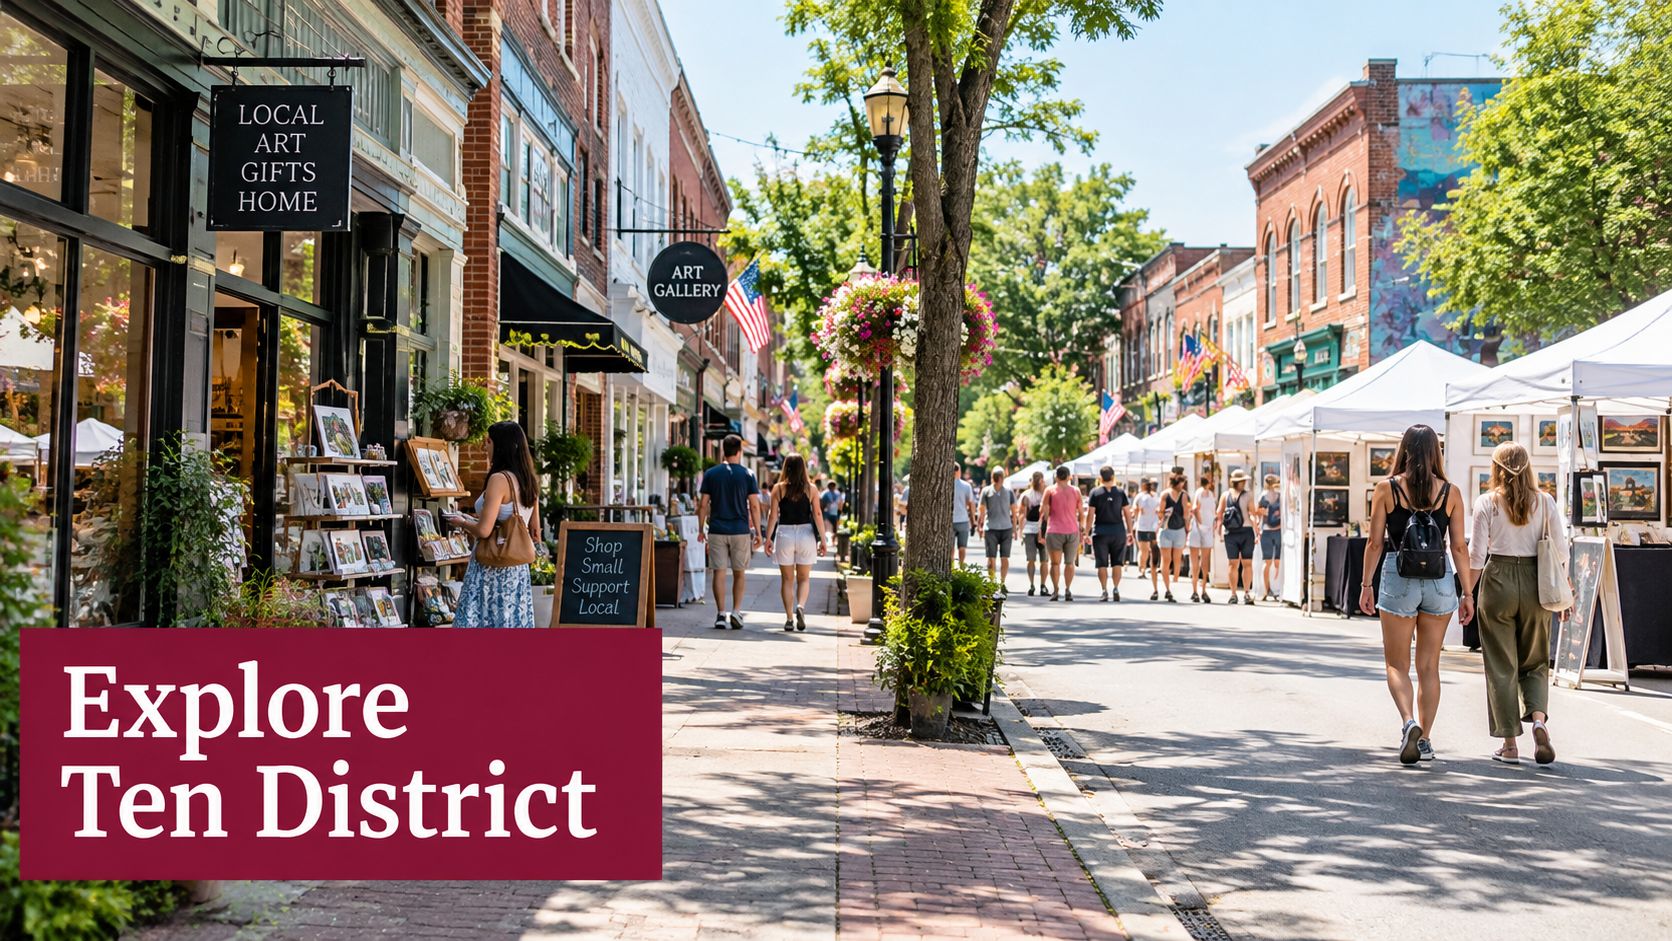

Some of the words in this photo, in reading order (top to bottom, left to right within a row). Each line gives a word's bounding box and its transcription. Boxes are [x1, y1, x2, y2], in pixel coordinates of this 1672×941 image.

[238, 104, 325, 125] LOCAL
[254, 132, 307, 154] ART
[241, 161, 316, 183] GIFTS
[237, 190, 318, 212] HOME
[671, 265, 704, 279] ART
[654, 283, 721, 298] GALLERY
[585, 536, 623, 558] Shop
[581, 557, 624, 575] Small
[571, 577, 631, 598] Support
[578, 598, 620, 616] Local
